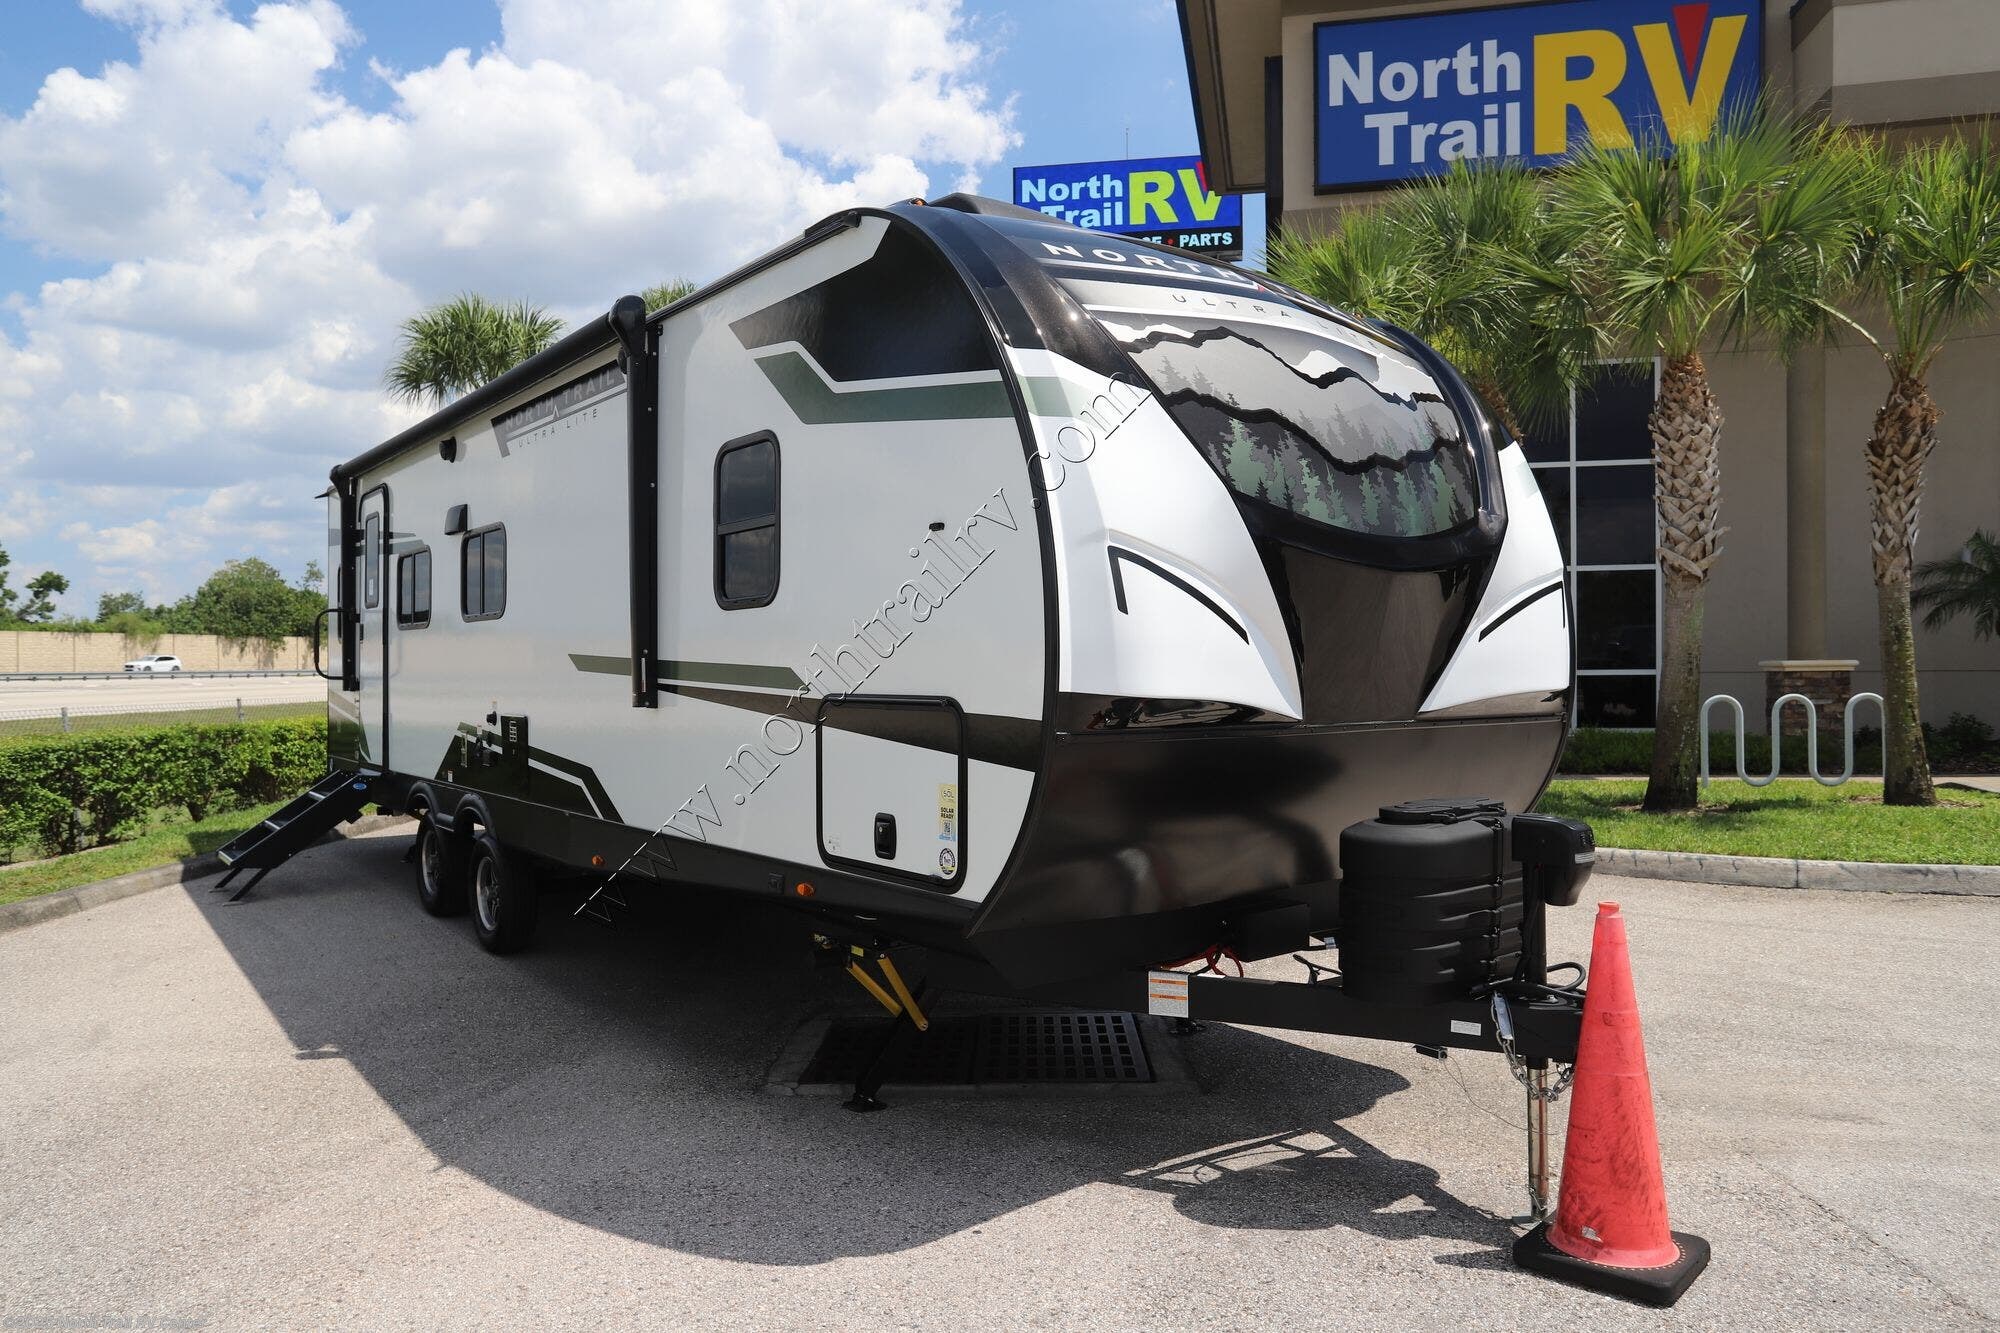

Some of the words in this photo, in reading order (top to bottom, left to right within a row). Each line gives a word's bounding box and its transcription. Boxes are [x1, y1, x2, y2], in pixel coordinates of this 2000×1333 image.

[1328, 38, 1521, 107] North
[1533, 14, 1748, 156] RV
[1363, 101, 1521, 167] Trail
[1021, 174, 1123, 203] North
[1128, 169, 1222, 226] RV
[1041, 242, 1246, 281] NORTH
[1179, 232, 1233, 248] PARTS
[1172, 294, 1292, 318] ULTRA
[505, 397, 555, 431] NORTH
[563, 369, 615, 405] TRAIL
[519, 427, 555, 448] ULTRA
[566, 408, 597, 429] LITE
